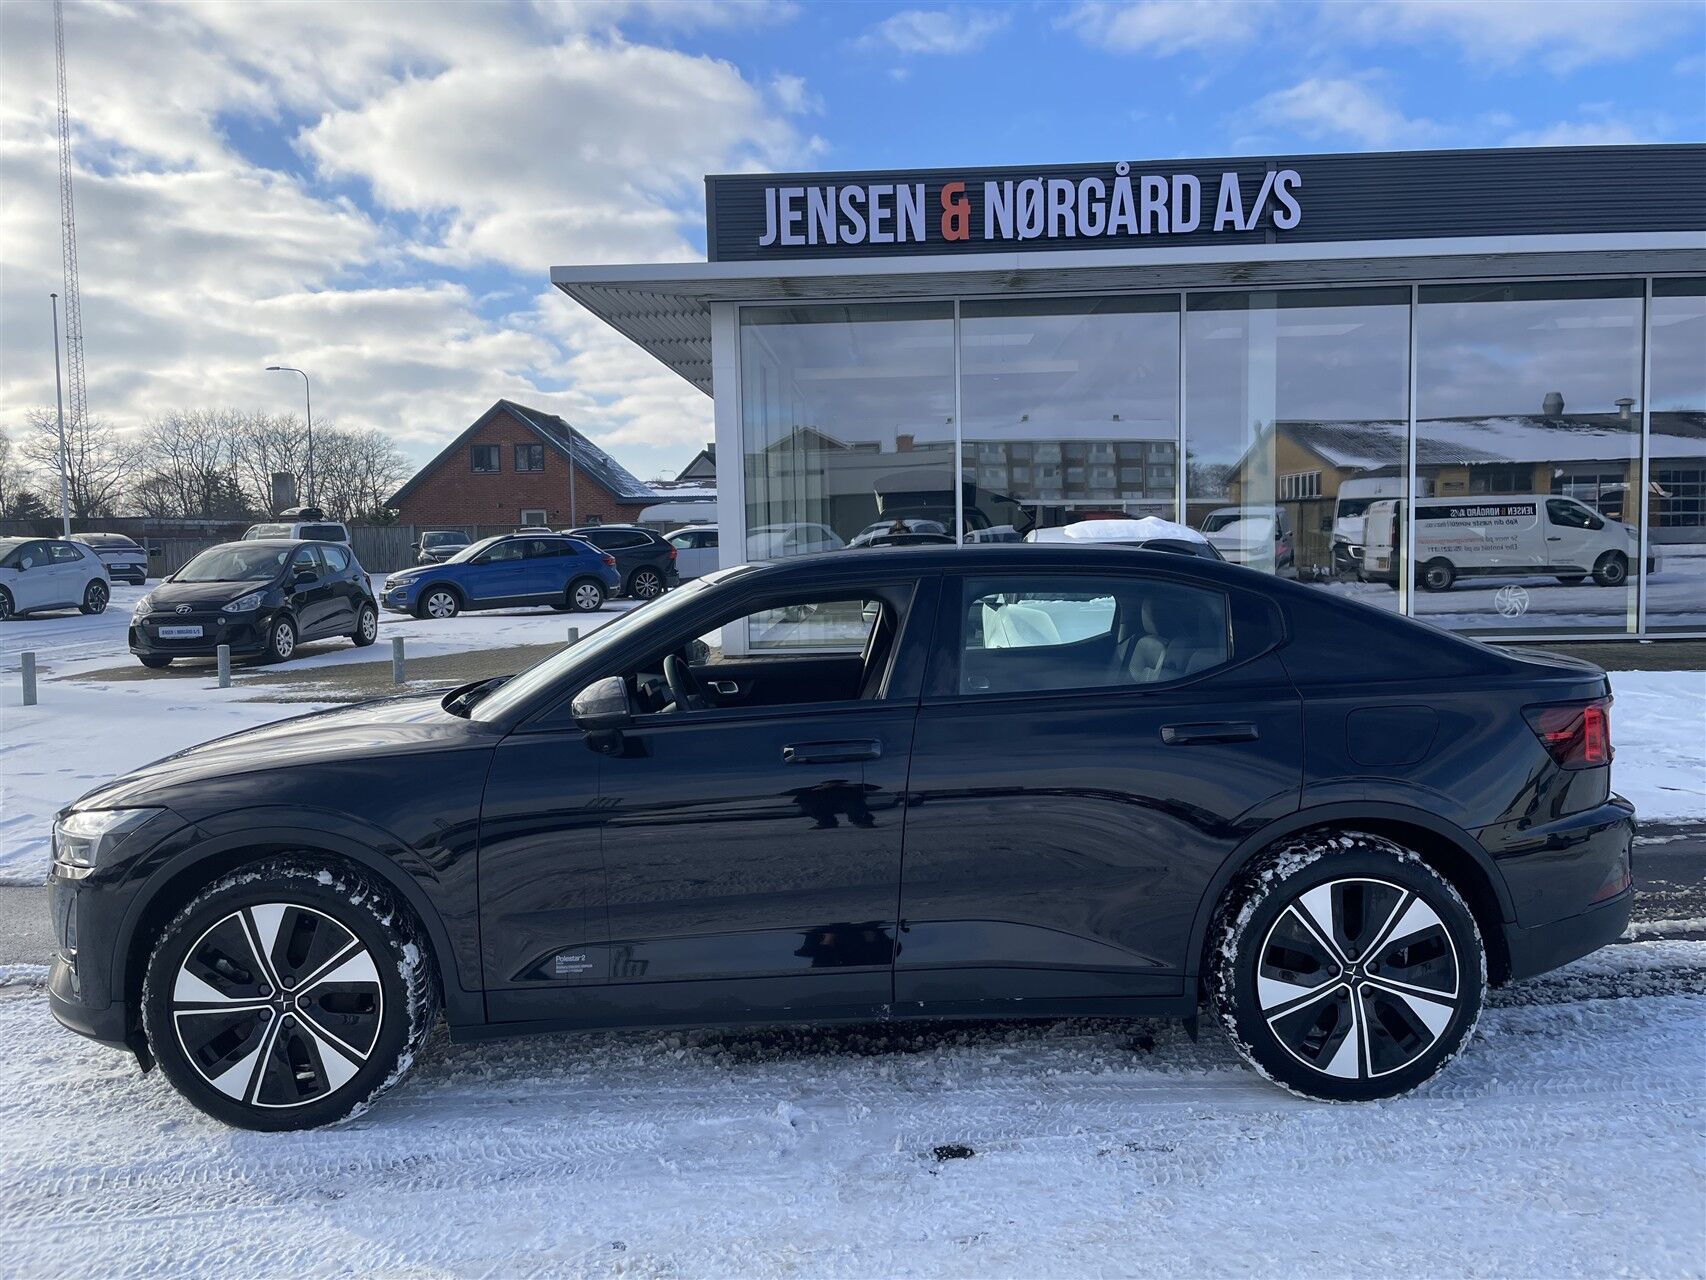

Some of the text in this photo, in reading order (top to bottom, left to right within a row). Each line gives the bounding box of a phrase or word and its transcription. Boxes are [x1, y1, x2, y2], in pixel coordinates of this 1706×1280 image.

[758, 161, 1303, 247] JENSEN & NØRGÅRD A/S
